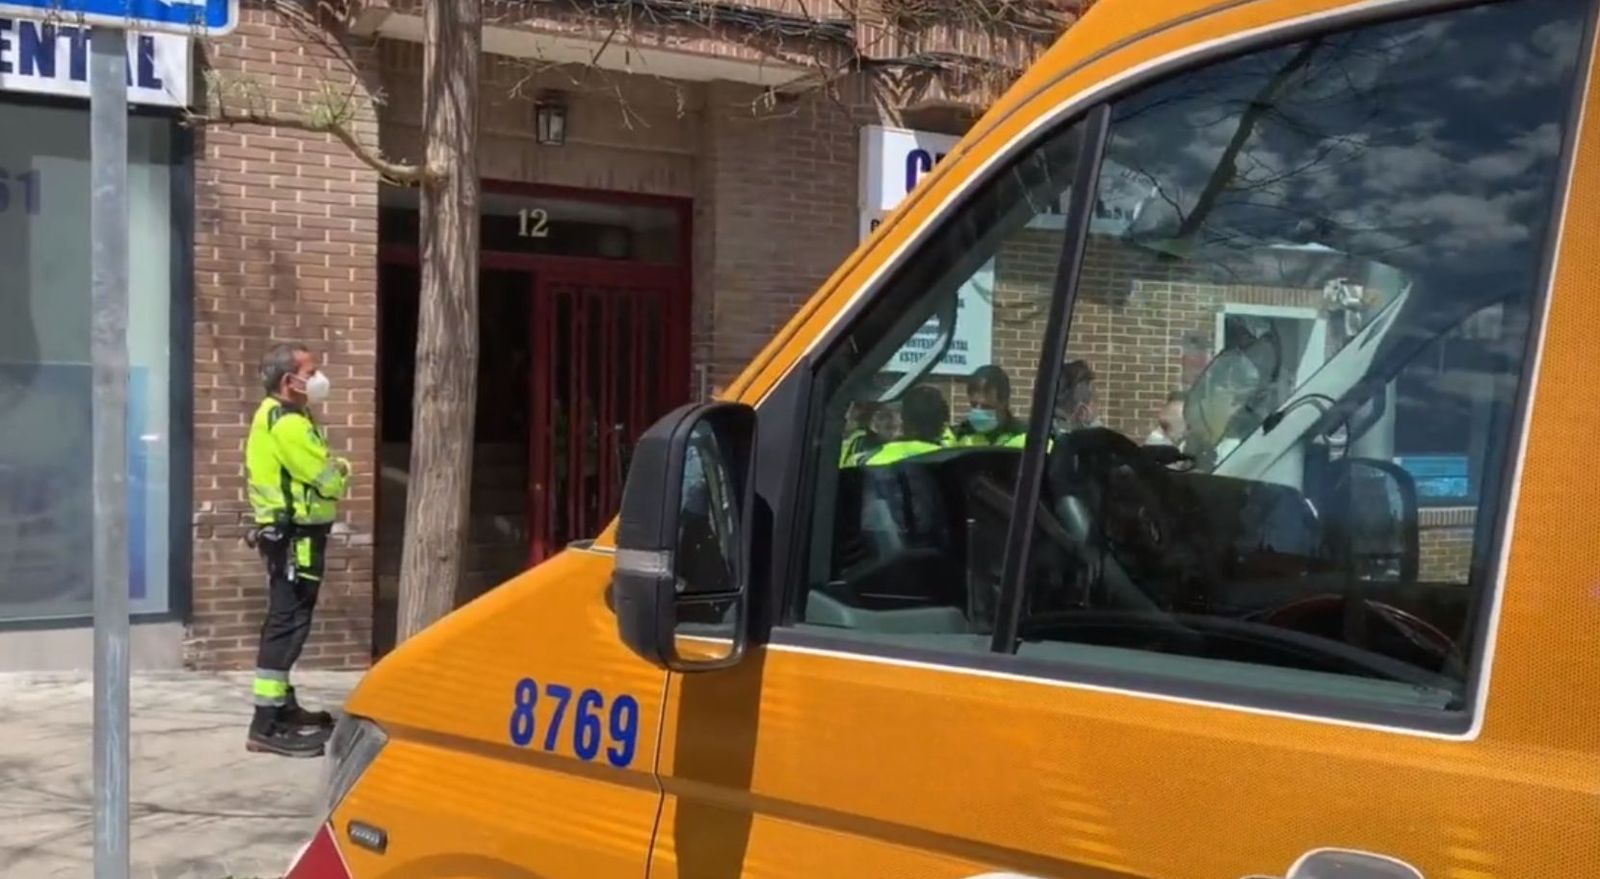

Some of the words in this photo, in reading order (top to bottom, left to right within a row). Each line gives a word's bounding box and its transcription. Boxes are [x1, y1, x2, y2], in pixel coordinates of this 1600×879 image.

[0, 18, 163, 90] ENTL
[517, 208, 549, 238] 12
[510, 677, 639, 767] 8769
